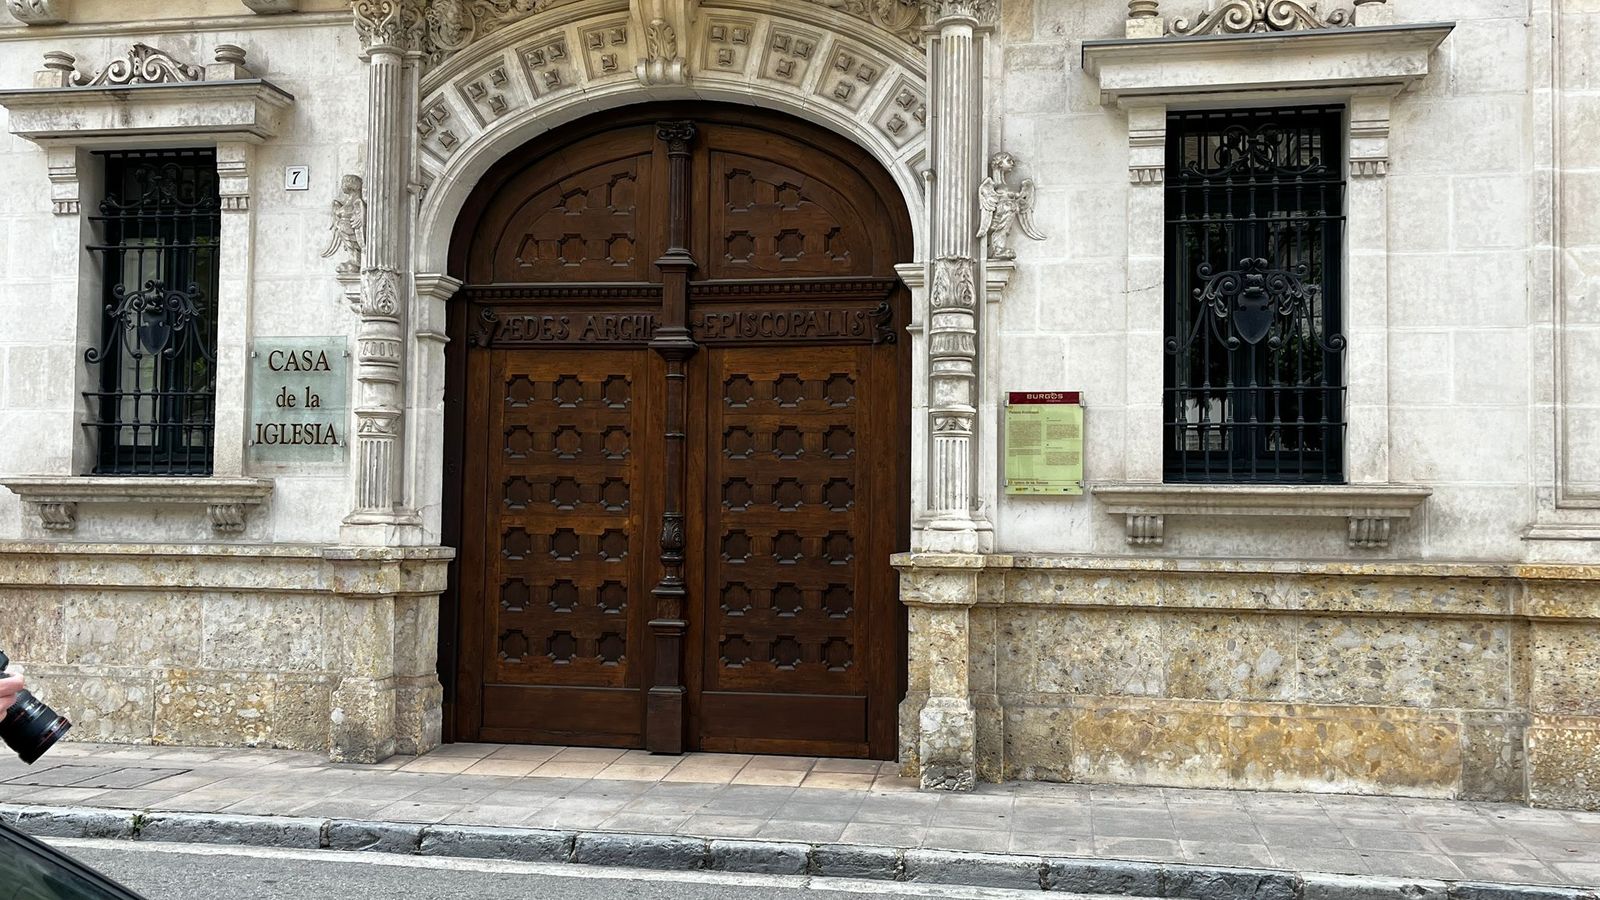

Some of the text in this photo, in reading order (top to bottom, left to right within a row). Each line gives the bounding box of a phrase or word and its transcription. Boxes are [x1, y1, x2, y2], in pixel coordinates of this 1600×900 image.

[292, 170, 302, 185] 7
[268, 350, 331, 372] CASA
[275, 386, 321, 408] de la
[255, 423, 339, 445] IGLESIA
